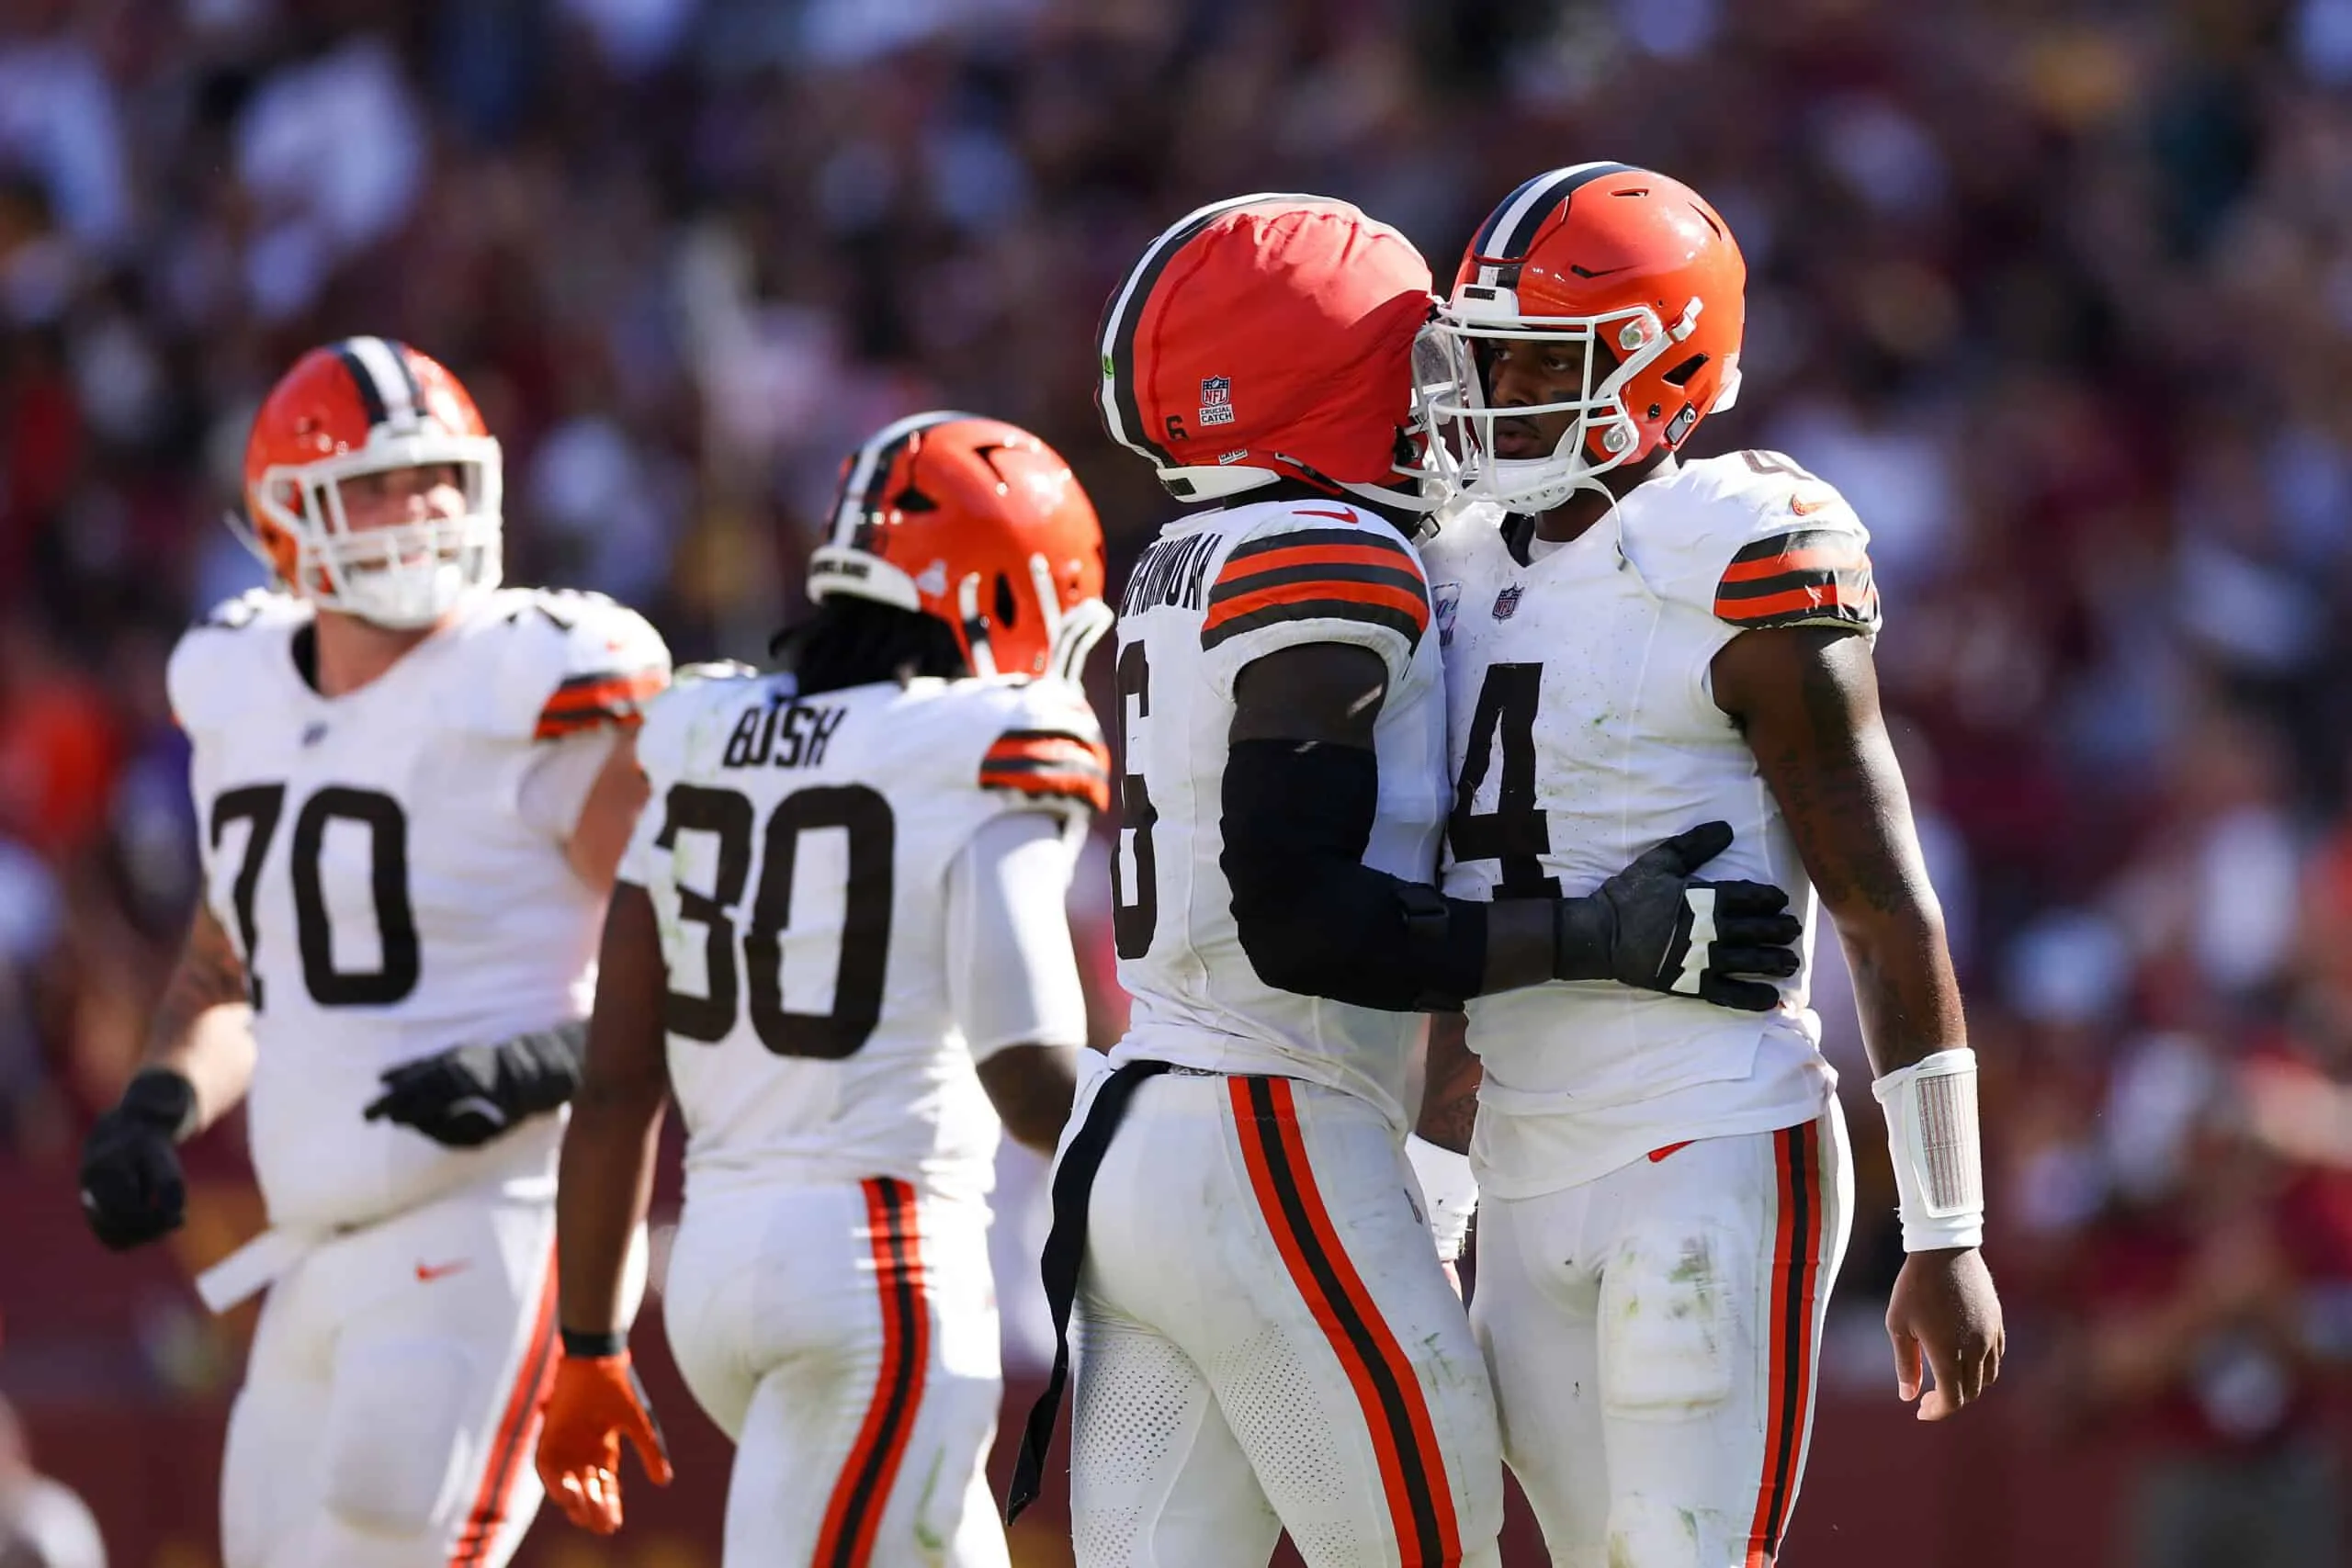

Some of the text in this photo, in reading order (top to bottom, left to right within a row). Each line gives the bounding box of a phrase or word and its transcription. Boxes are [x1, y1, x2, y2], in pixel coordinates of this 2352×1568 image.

[1200, 406, 1230, 415] CRUCIAL
[1204, 389, 1226, 404] NFL
[1201, 413, 1232, 423] CATCH
[1495, 600, 1513, 615] NFL
[722, 705, 848, 768] BUSH
[1448, 662, 1562, 899] 4
[211, 783, 419, 1013] 70
[655, 784, 896, 1061] 30
